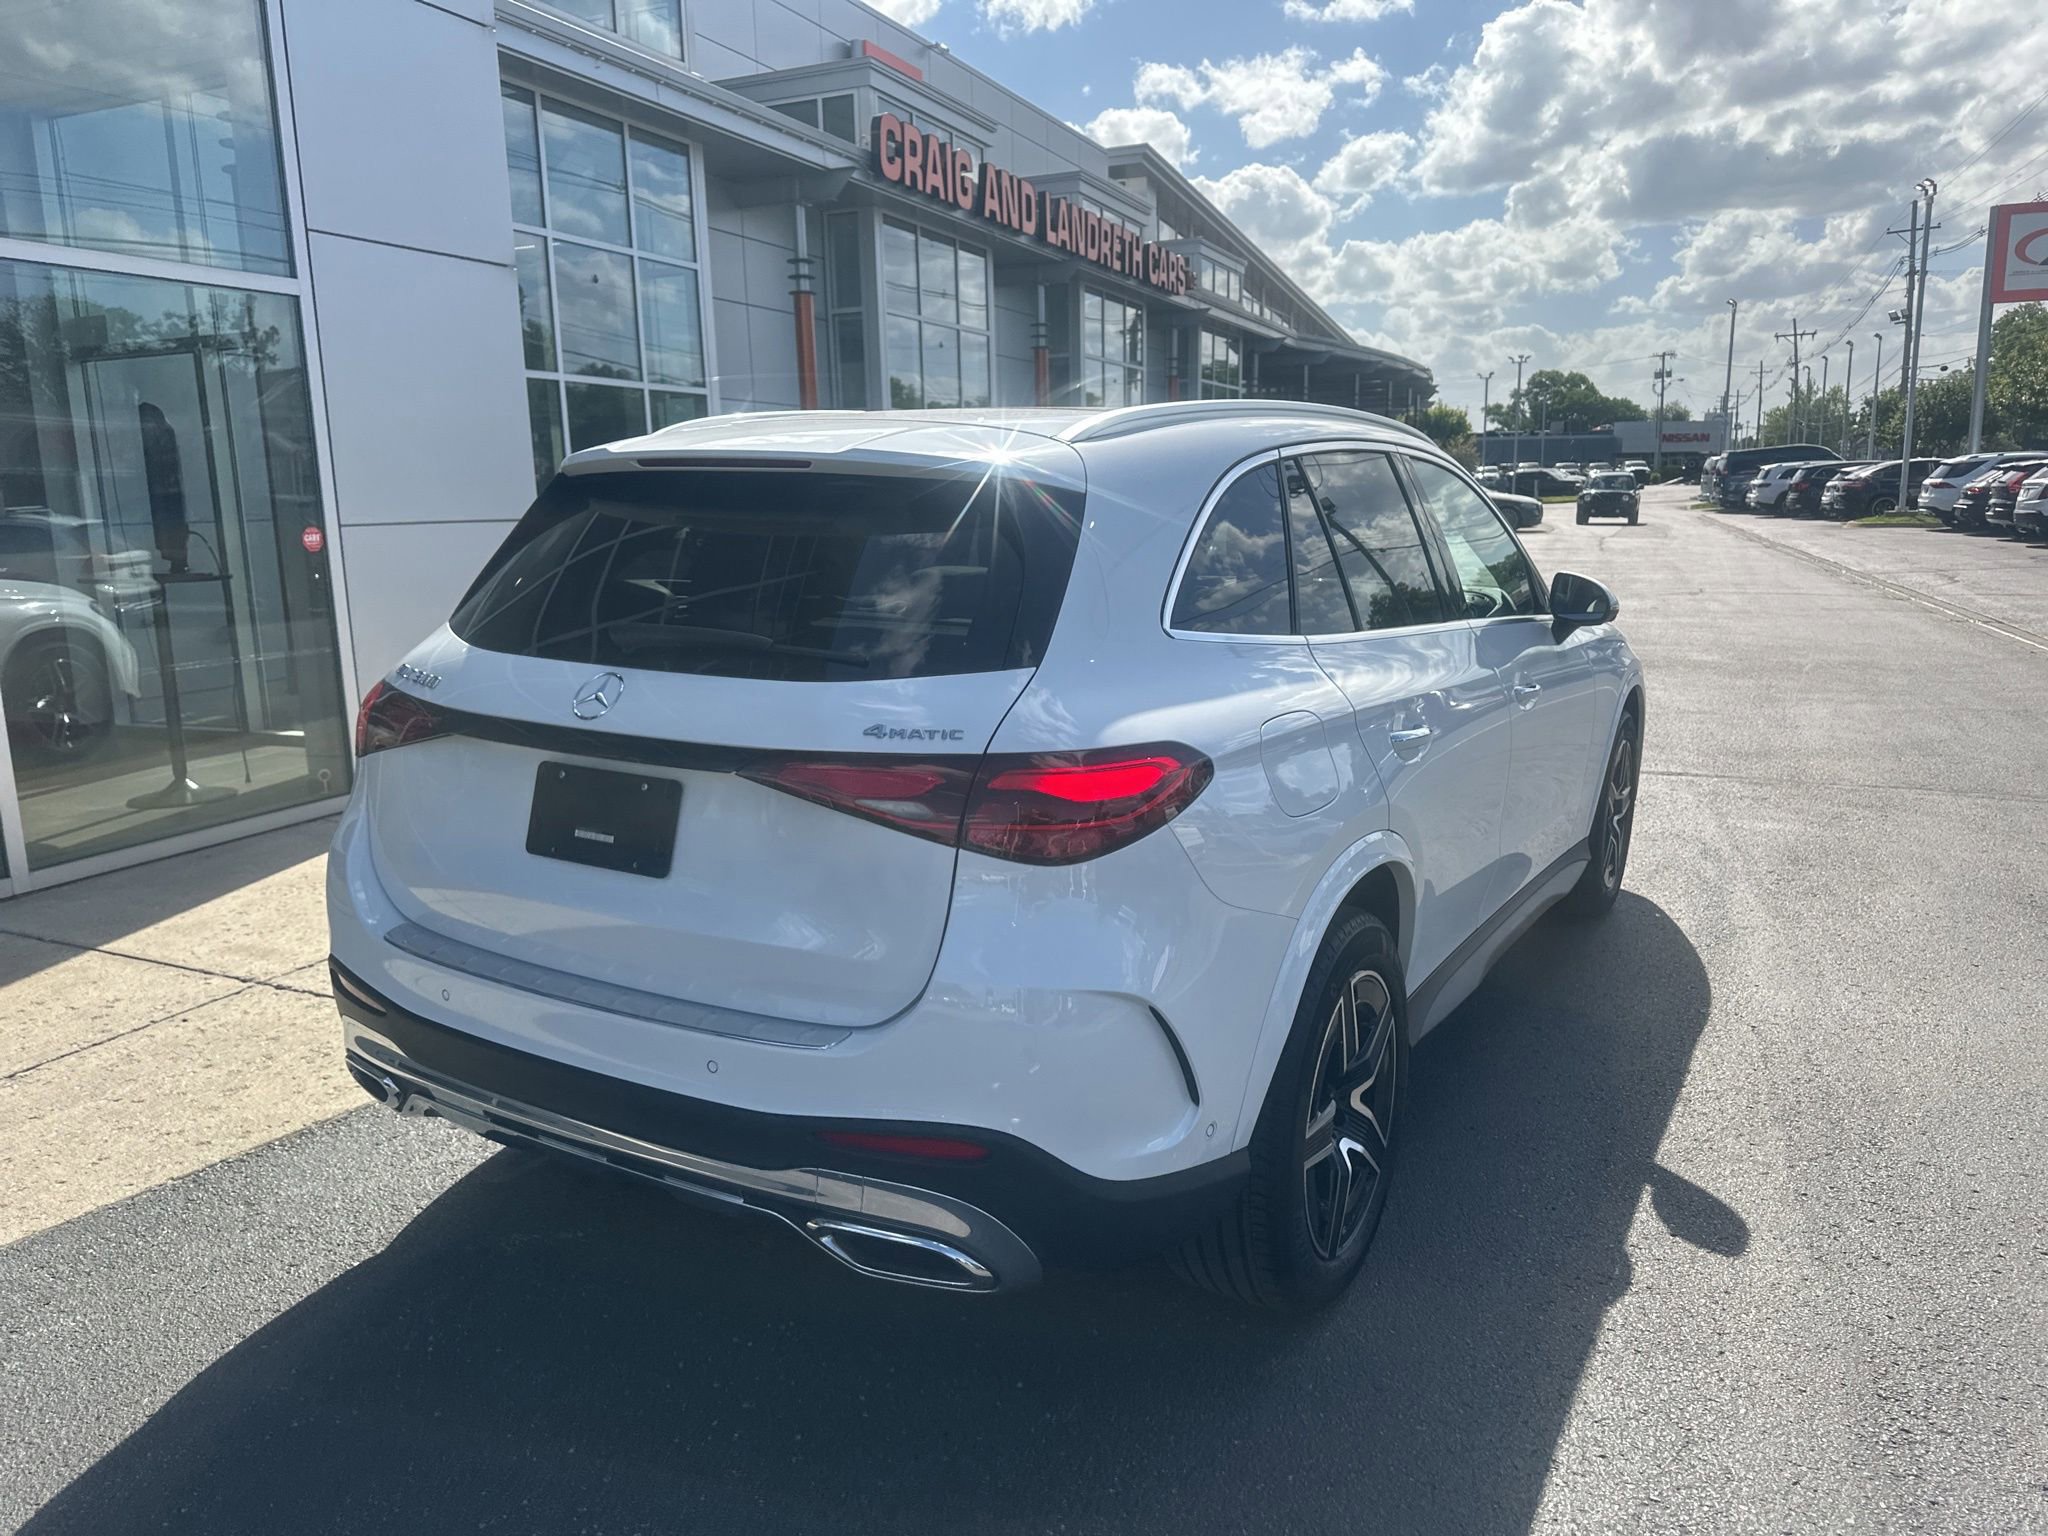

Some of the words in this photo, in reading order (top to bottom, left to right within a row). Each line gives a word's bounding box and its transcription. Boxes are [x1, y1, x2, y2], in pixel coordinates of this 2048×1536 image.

[878, 112, 973, 210] CRAIG
[984, 162, 1037, 236] AND
[1045, 191, 1143, 280] LANDRETH
[1148, 242, 1186, 296] CARS
[1661, 432, 1711, 443] NISSAN
[862, 723, 965, 741] 4MATIC
